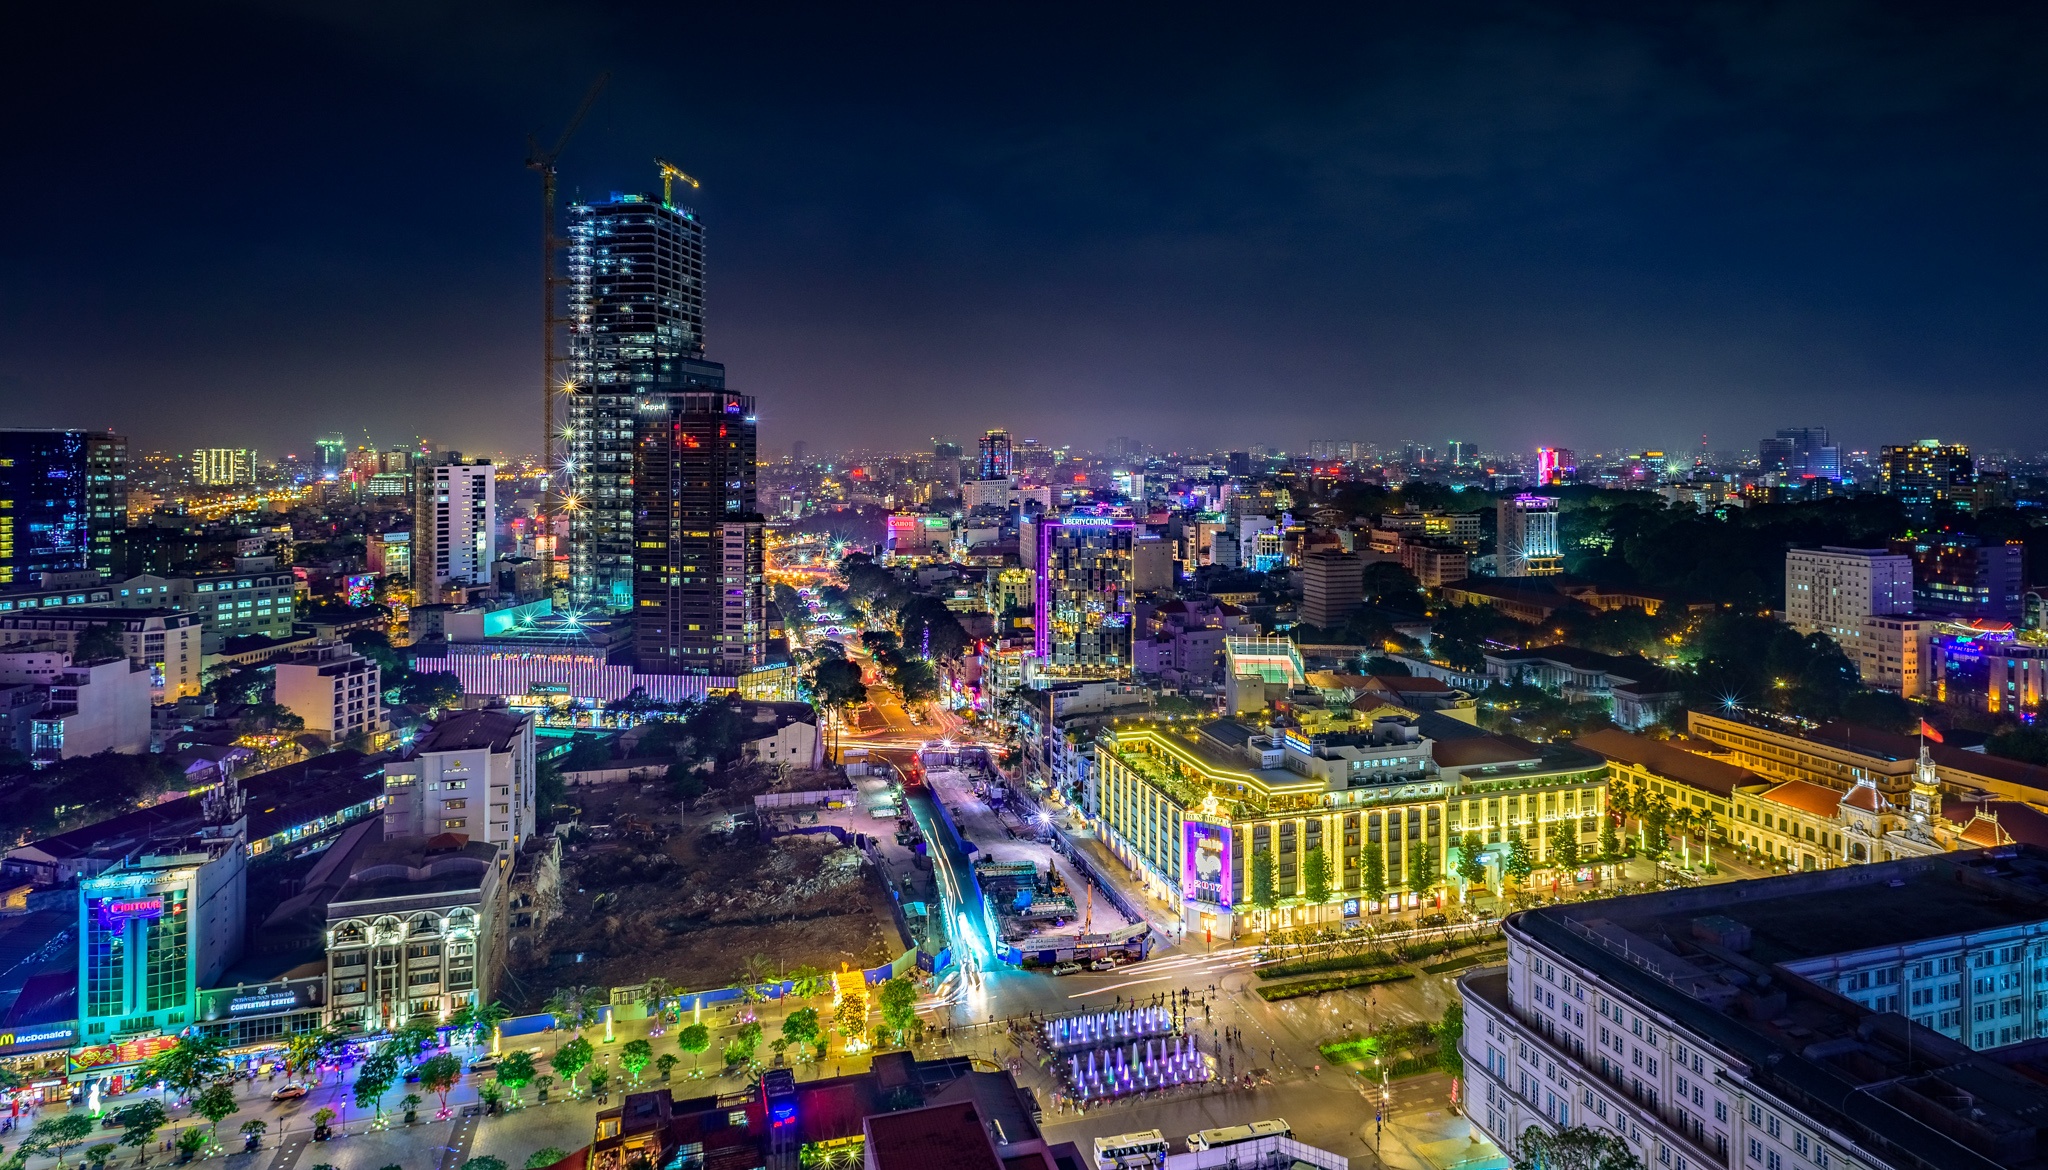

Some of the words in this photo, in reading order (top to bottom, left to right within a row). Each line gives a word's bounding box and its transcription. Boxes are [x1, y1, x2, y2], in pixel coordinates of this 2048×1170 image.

[641, 403, 666, 412] Keppel
[1063, 518, 1085, 526] LIBERTY
[1086, 518, 1112, 526] CENTRAL
[1194, 880, 1223, 892] 2017
[230, 1000, 270, 1011] CONVENTION
[270, 997, 296, 1007] CENTER
[16, 1030, 72, 1044] McDonald's
